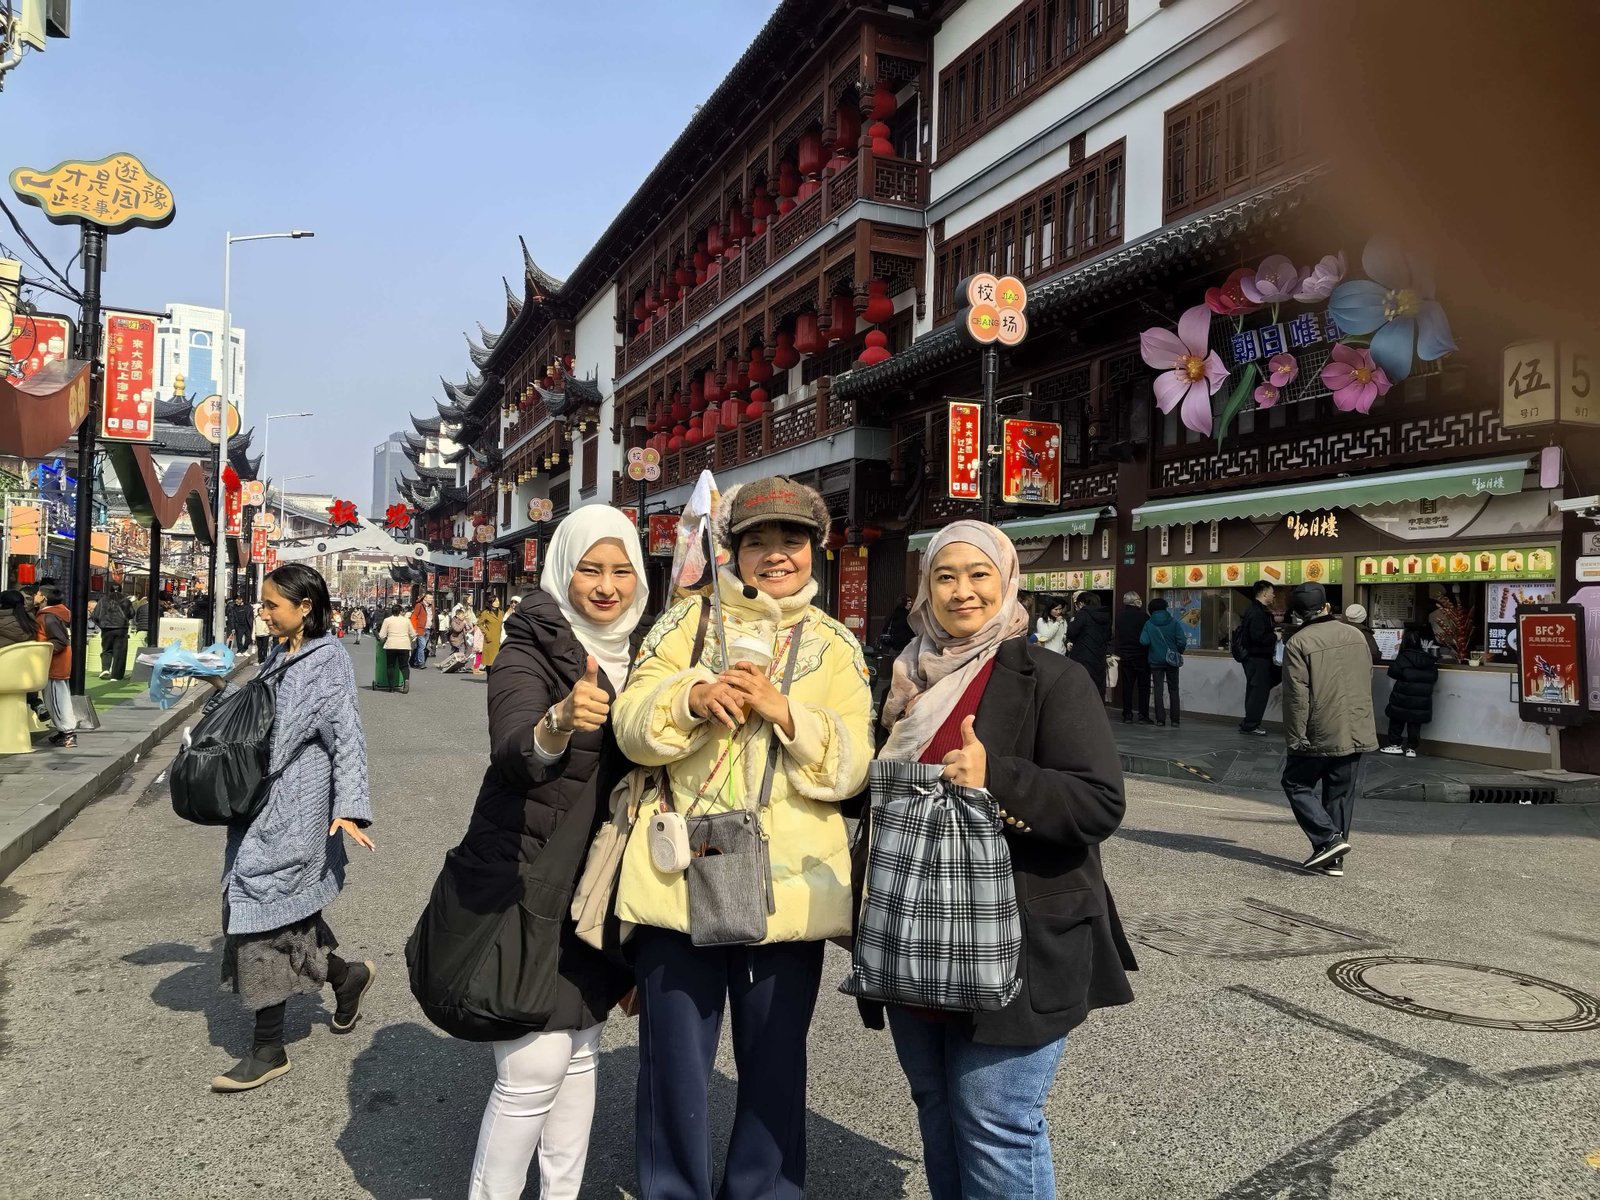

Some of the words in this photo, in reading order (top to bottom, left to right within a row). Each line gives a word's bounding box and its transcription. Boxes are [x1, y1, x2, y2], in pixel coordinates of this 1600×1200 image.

[977, 283, 993, 302] 校
[1002, 292, 1020, 301] JIAO
[971, 317, 999, 327] CHANG
[1003, 315, 1017, 333] 场
[1508, 359, 1551, 400] 伍
[1520, 407, 1539, 418] 号门
[1535, 626, 1554, 636] BFC
